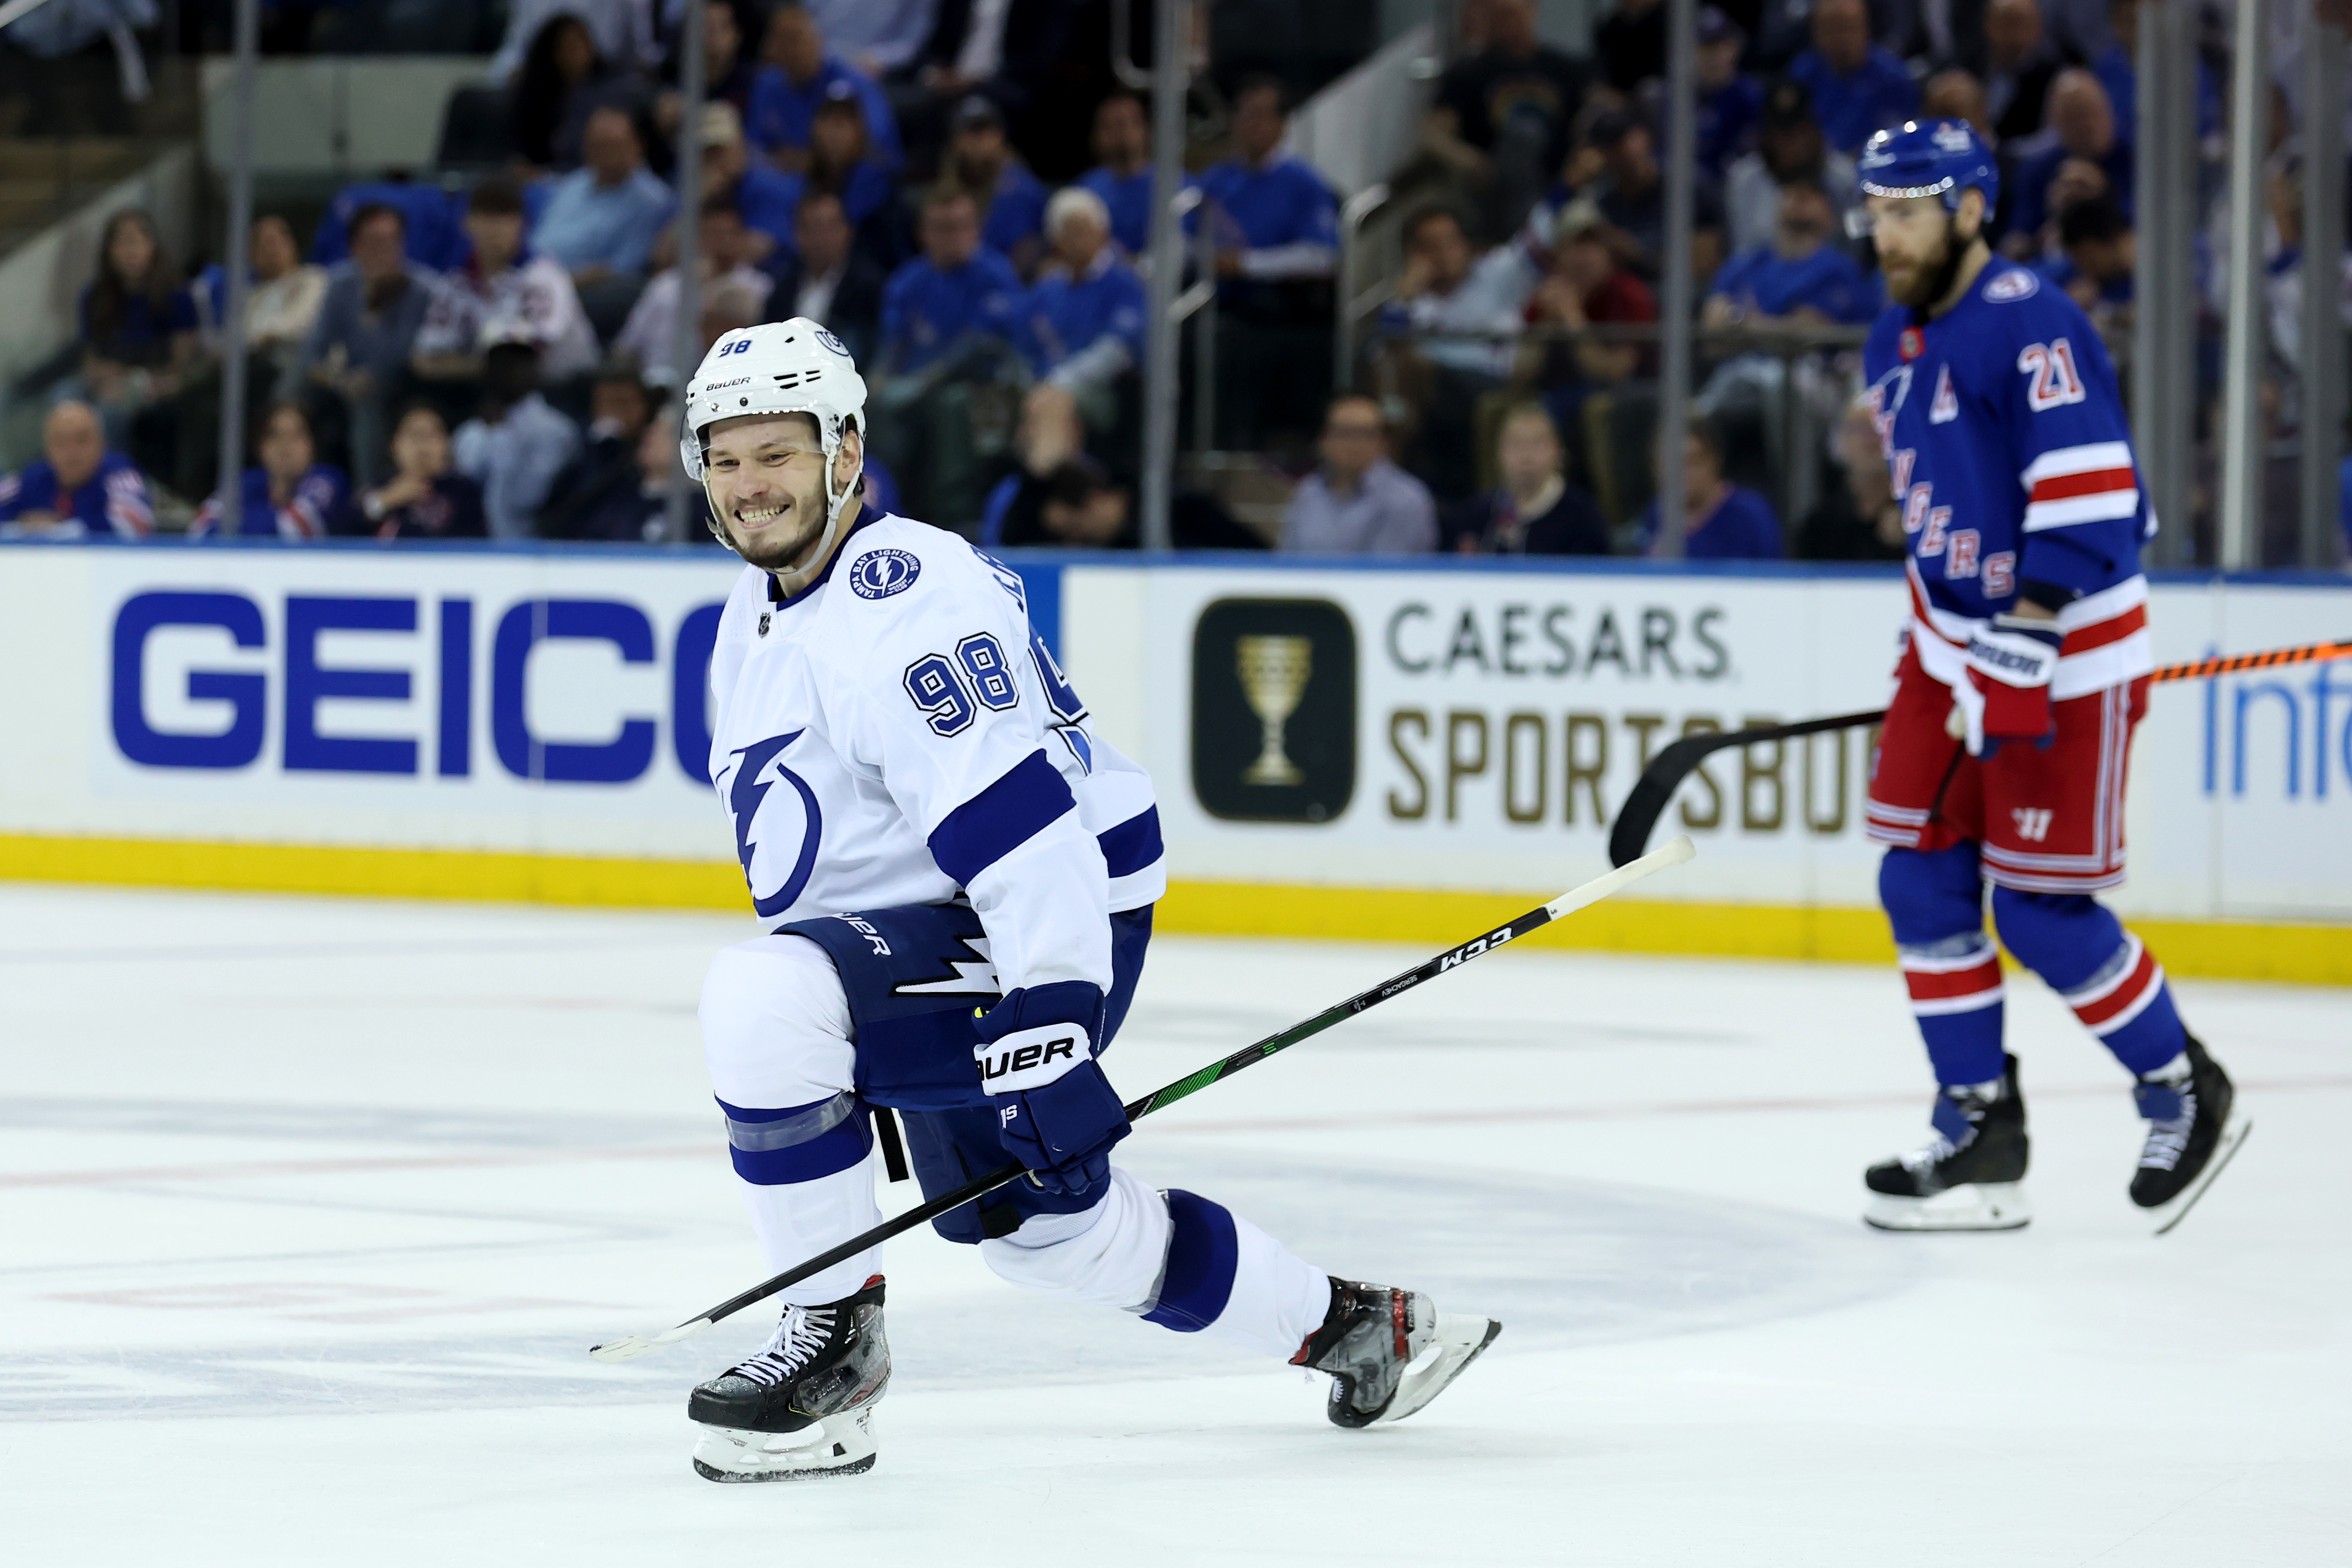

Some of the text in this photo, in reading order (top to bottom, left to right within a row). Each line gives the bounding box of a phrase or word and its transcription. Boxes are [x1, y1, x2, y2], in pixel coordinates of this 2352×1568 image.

[706, 377, 751, 391] BAUER
[718, 340, 752, 357] 98
[2017, 337, 2085, 412] 21
[852, 549, 919, 598] TAMPA BAY LIGHTNING
[1386, 603, 1731, 680] CAESARS
[110, 588, 724, 788] GEIC
[903, 631, 1020, 738] 98
[2202, 643, 2352, 799] Inf
[1386, 707, 1882, 835] SPORTSBO
[1381, 974, 1418, 997] SERGACHEV
[1440, 926, 1513, 972] CCM
